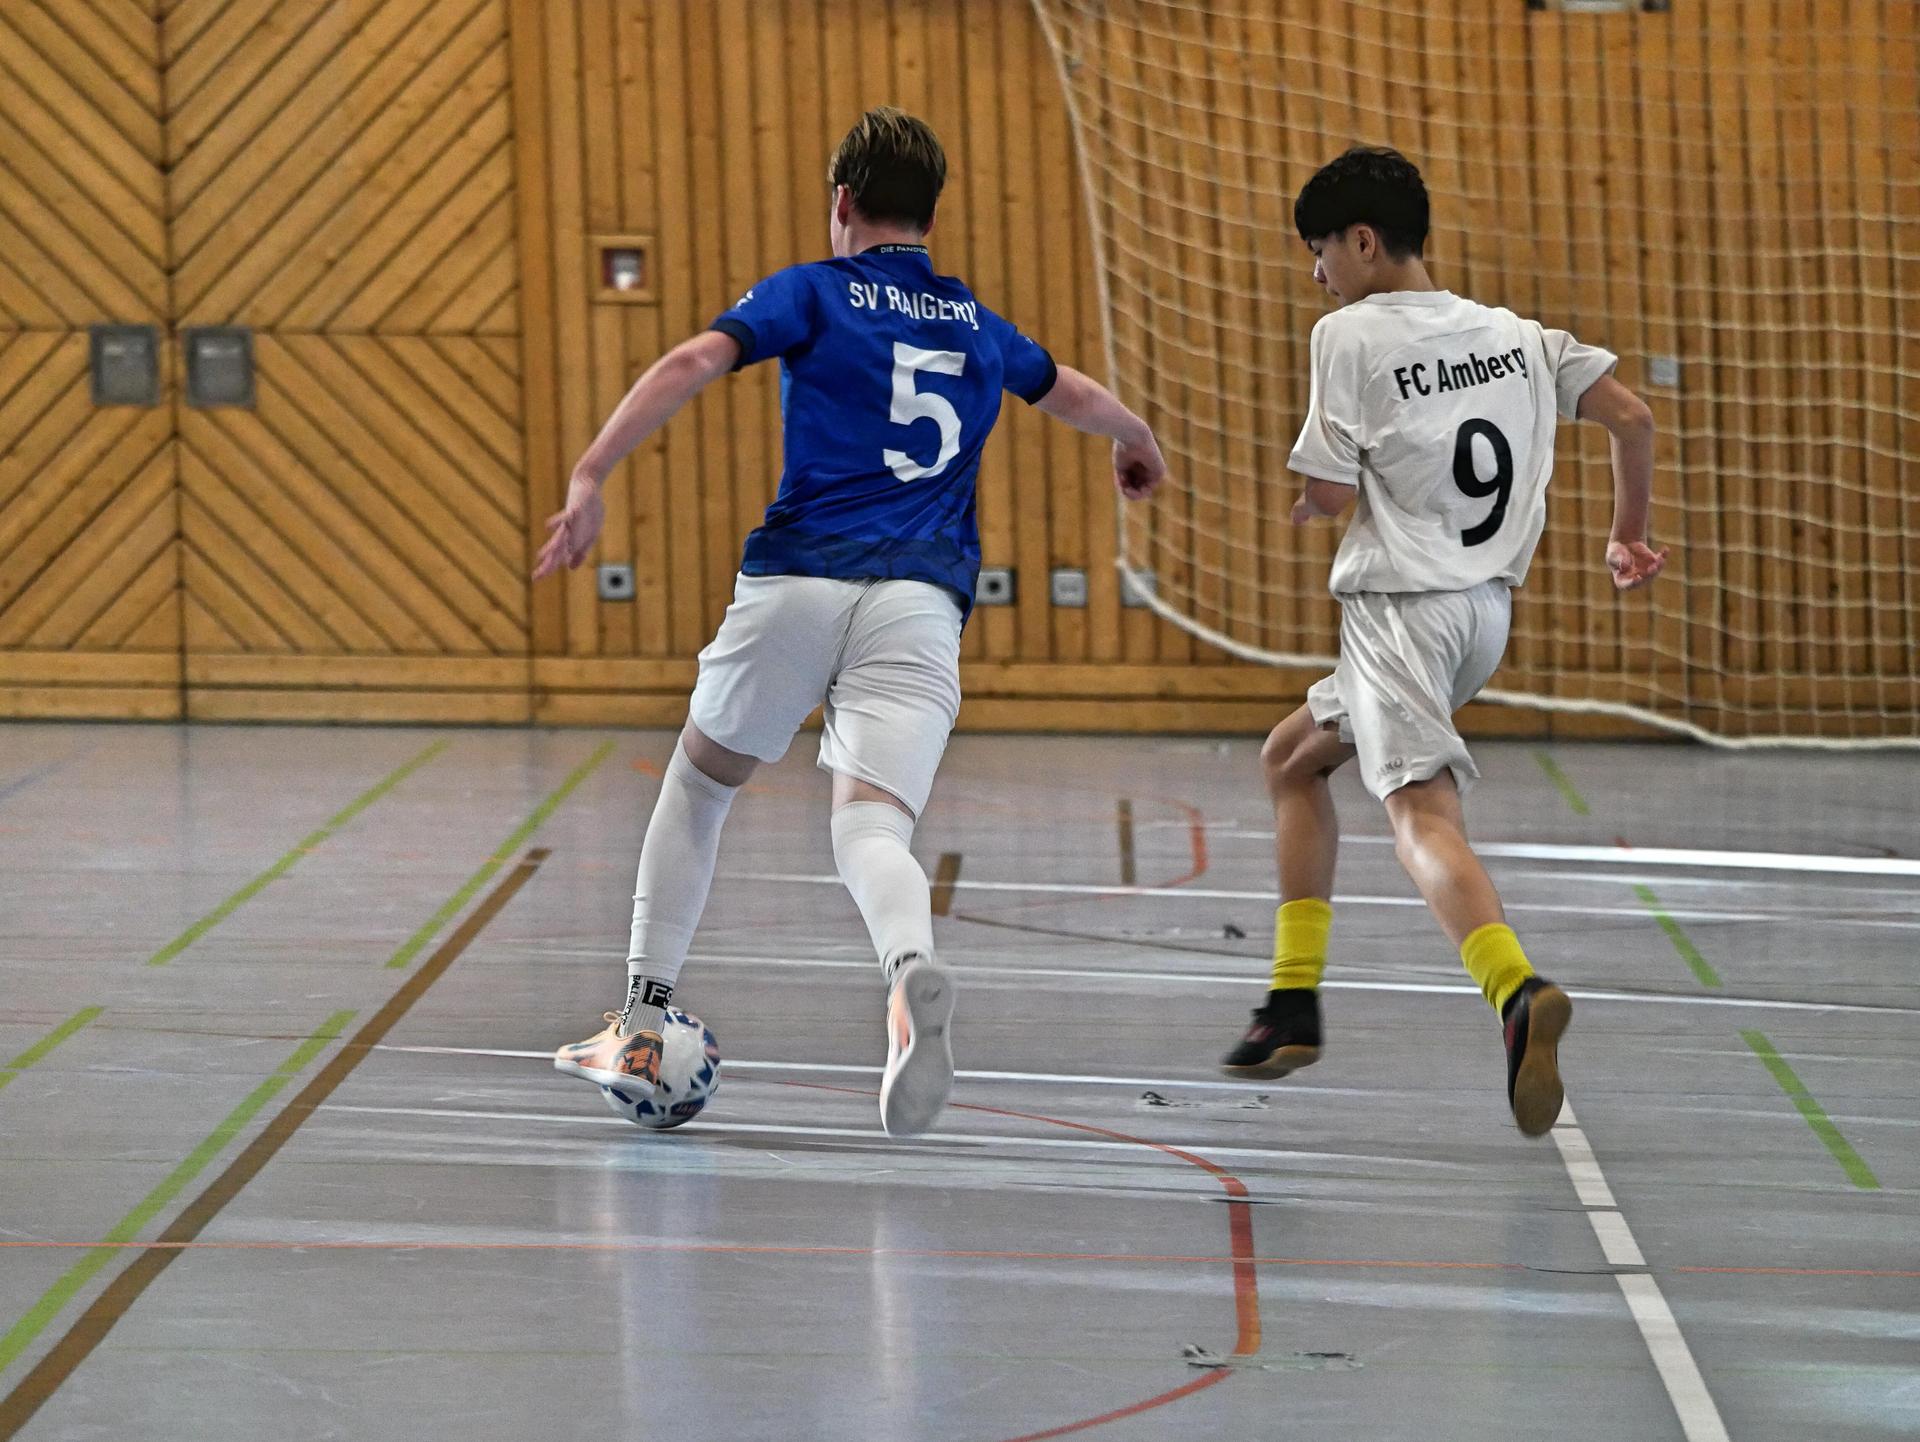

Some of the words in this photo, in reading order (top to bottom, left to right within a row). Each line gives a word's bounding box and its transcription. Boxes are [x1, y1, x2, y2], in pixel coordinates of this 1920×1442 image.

[880, 246, 895, 254] DIE
[849, 281, 879, 311] SV
[1393, 362, 1432, 400] FC
[1437, 347, 1528, 393] Amberg
[882, 340, 967, 483] 5
[1452, 417, 1514, 547] 9
